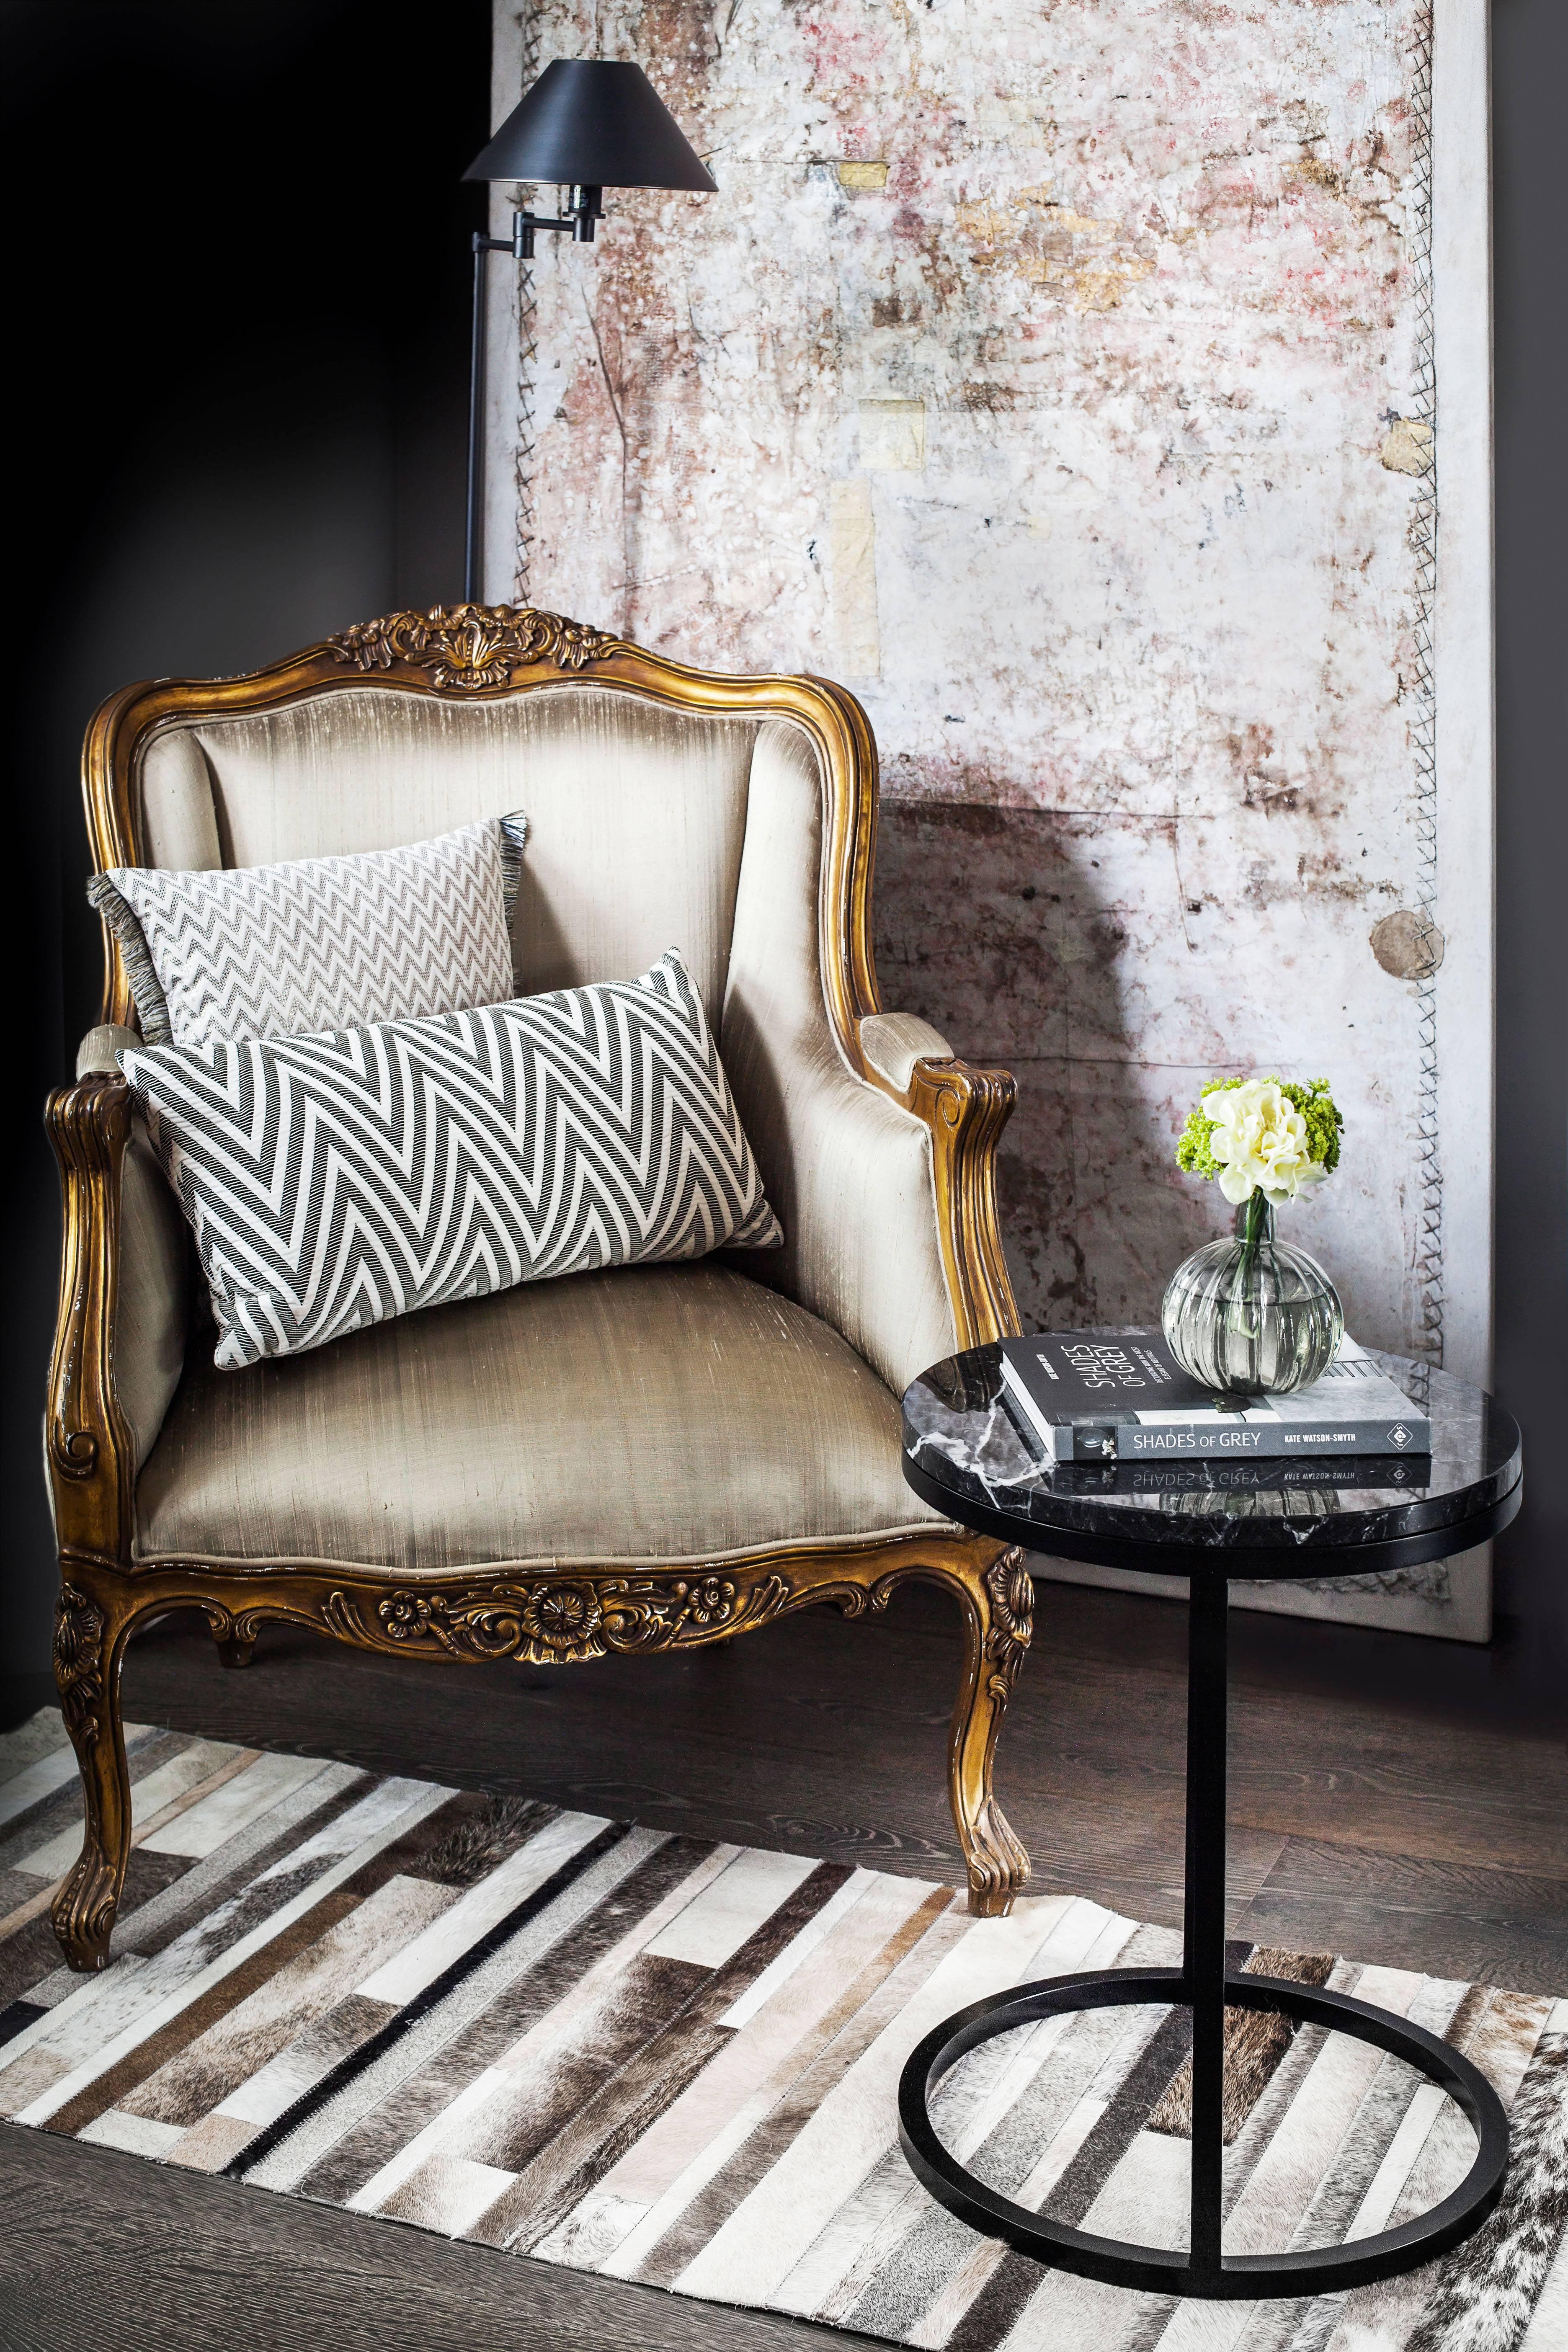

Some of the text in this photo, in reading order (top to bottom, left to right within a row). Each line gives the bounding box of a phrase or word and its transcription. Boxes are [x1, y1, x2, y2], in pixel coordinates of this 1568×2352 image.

[1144, 1350, 1160, 1363] NEUTRALS
[1061, 1345, 1115, 1387] SHADES
[1090, 1345, 1146, 1387] OF GREY
[1157, 1368, 1172, 1379] ELEGANT
[1146, 1367, 1164, 1383] DECORATING
[1133, 1432, 1261, 1449] SHADES OF GREY
[1303, 1434, 1356, 1442] WATSON-SMYTH
